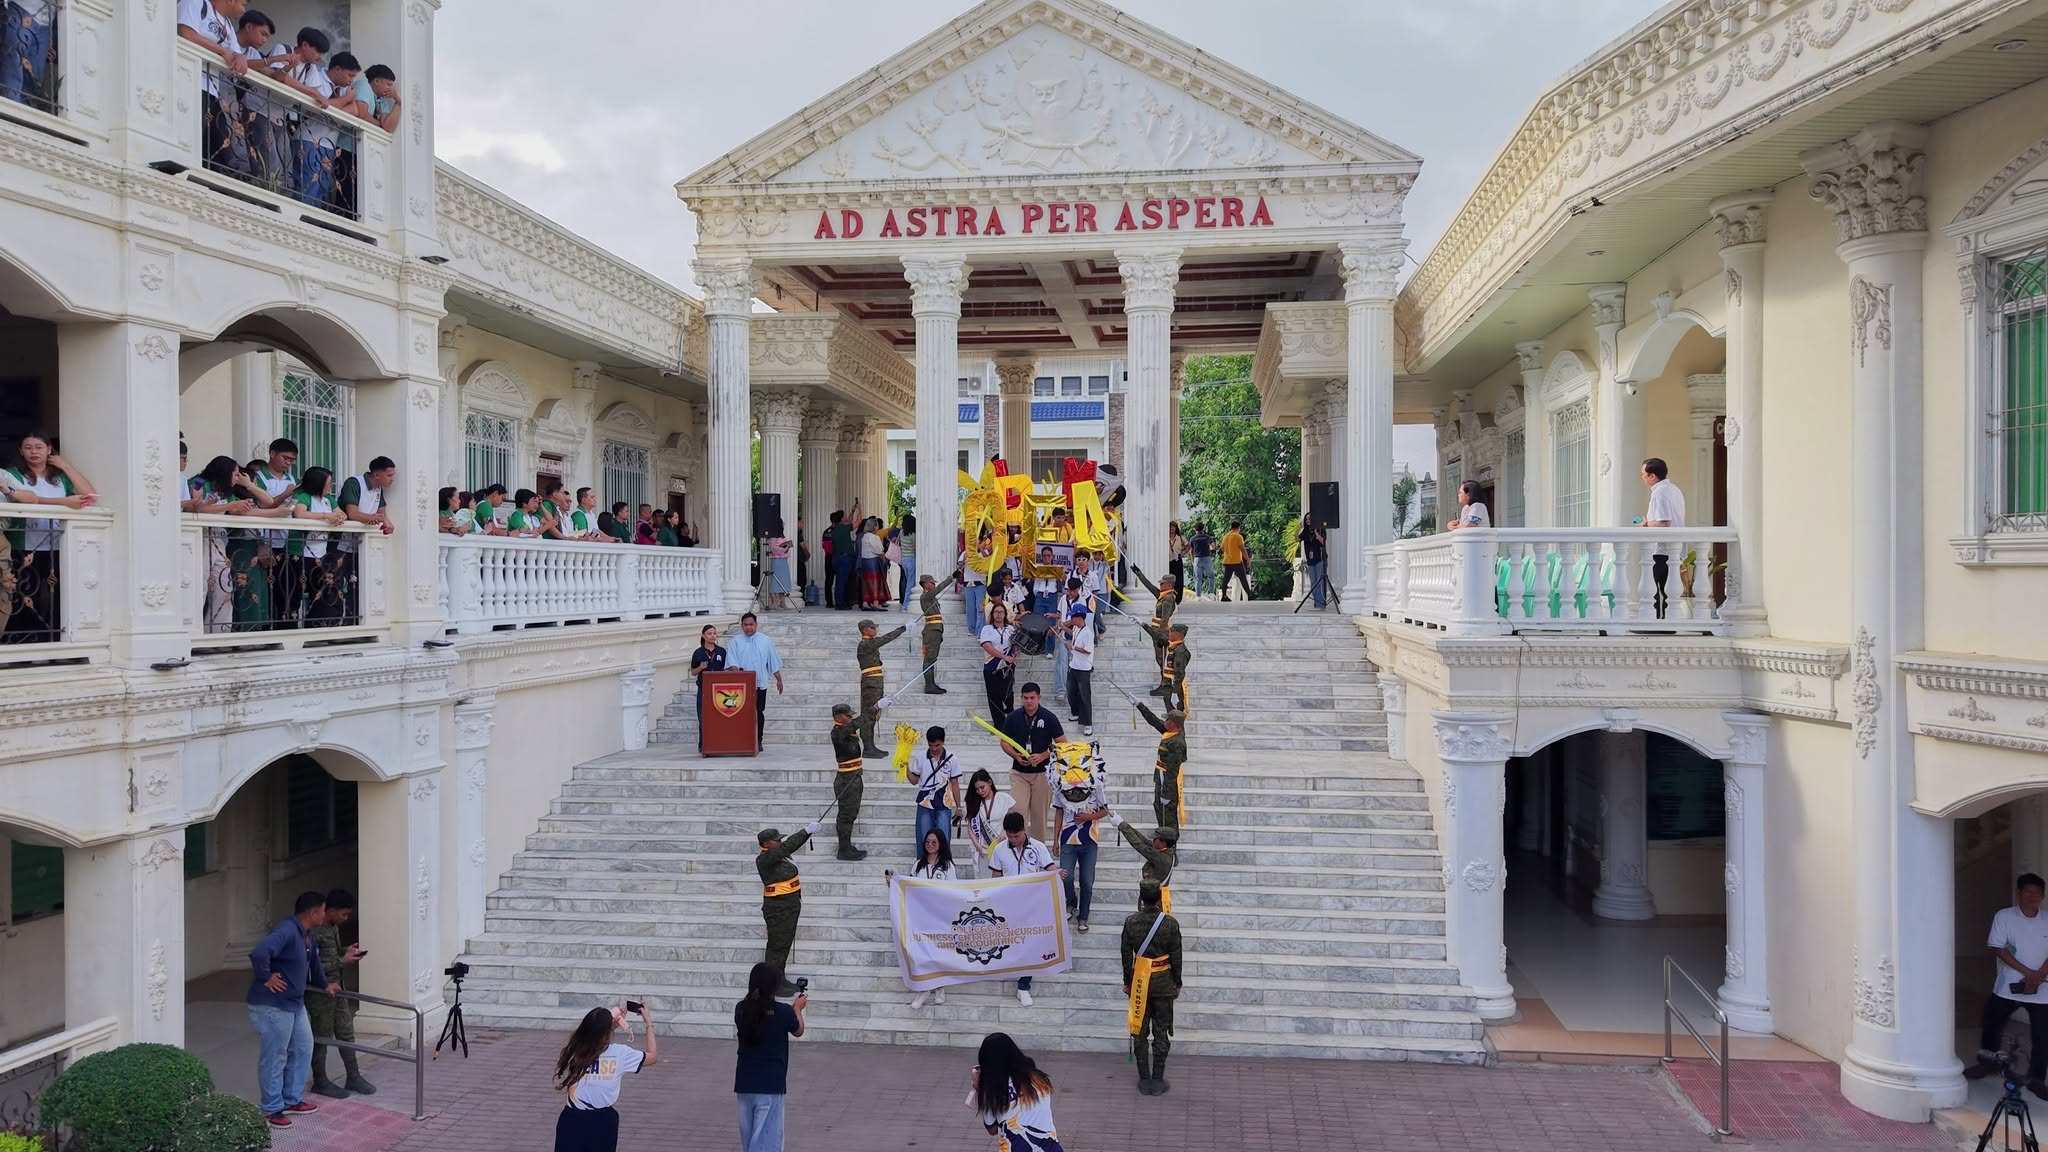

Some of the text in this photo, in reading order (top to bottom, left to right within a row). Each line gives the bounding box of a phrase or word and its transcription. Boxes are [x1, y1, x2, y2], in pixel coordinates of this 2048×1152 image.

[813, 196, 1275, 239] AD ASTRA PER ASPERA
[951, 924, 994, 934] COLLEGE
[996, 922, 1008, 931] OF
[958, 925, 1054, 941] ENTREPRENEURSHIP
[937, 935, 1026, 949] AND ACCOUNTANCY
